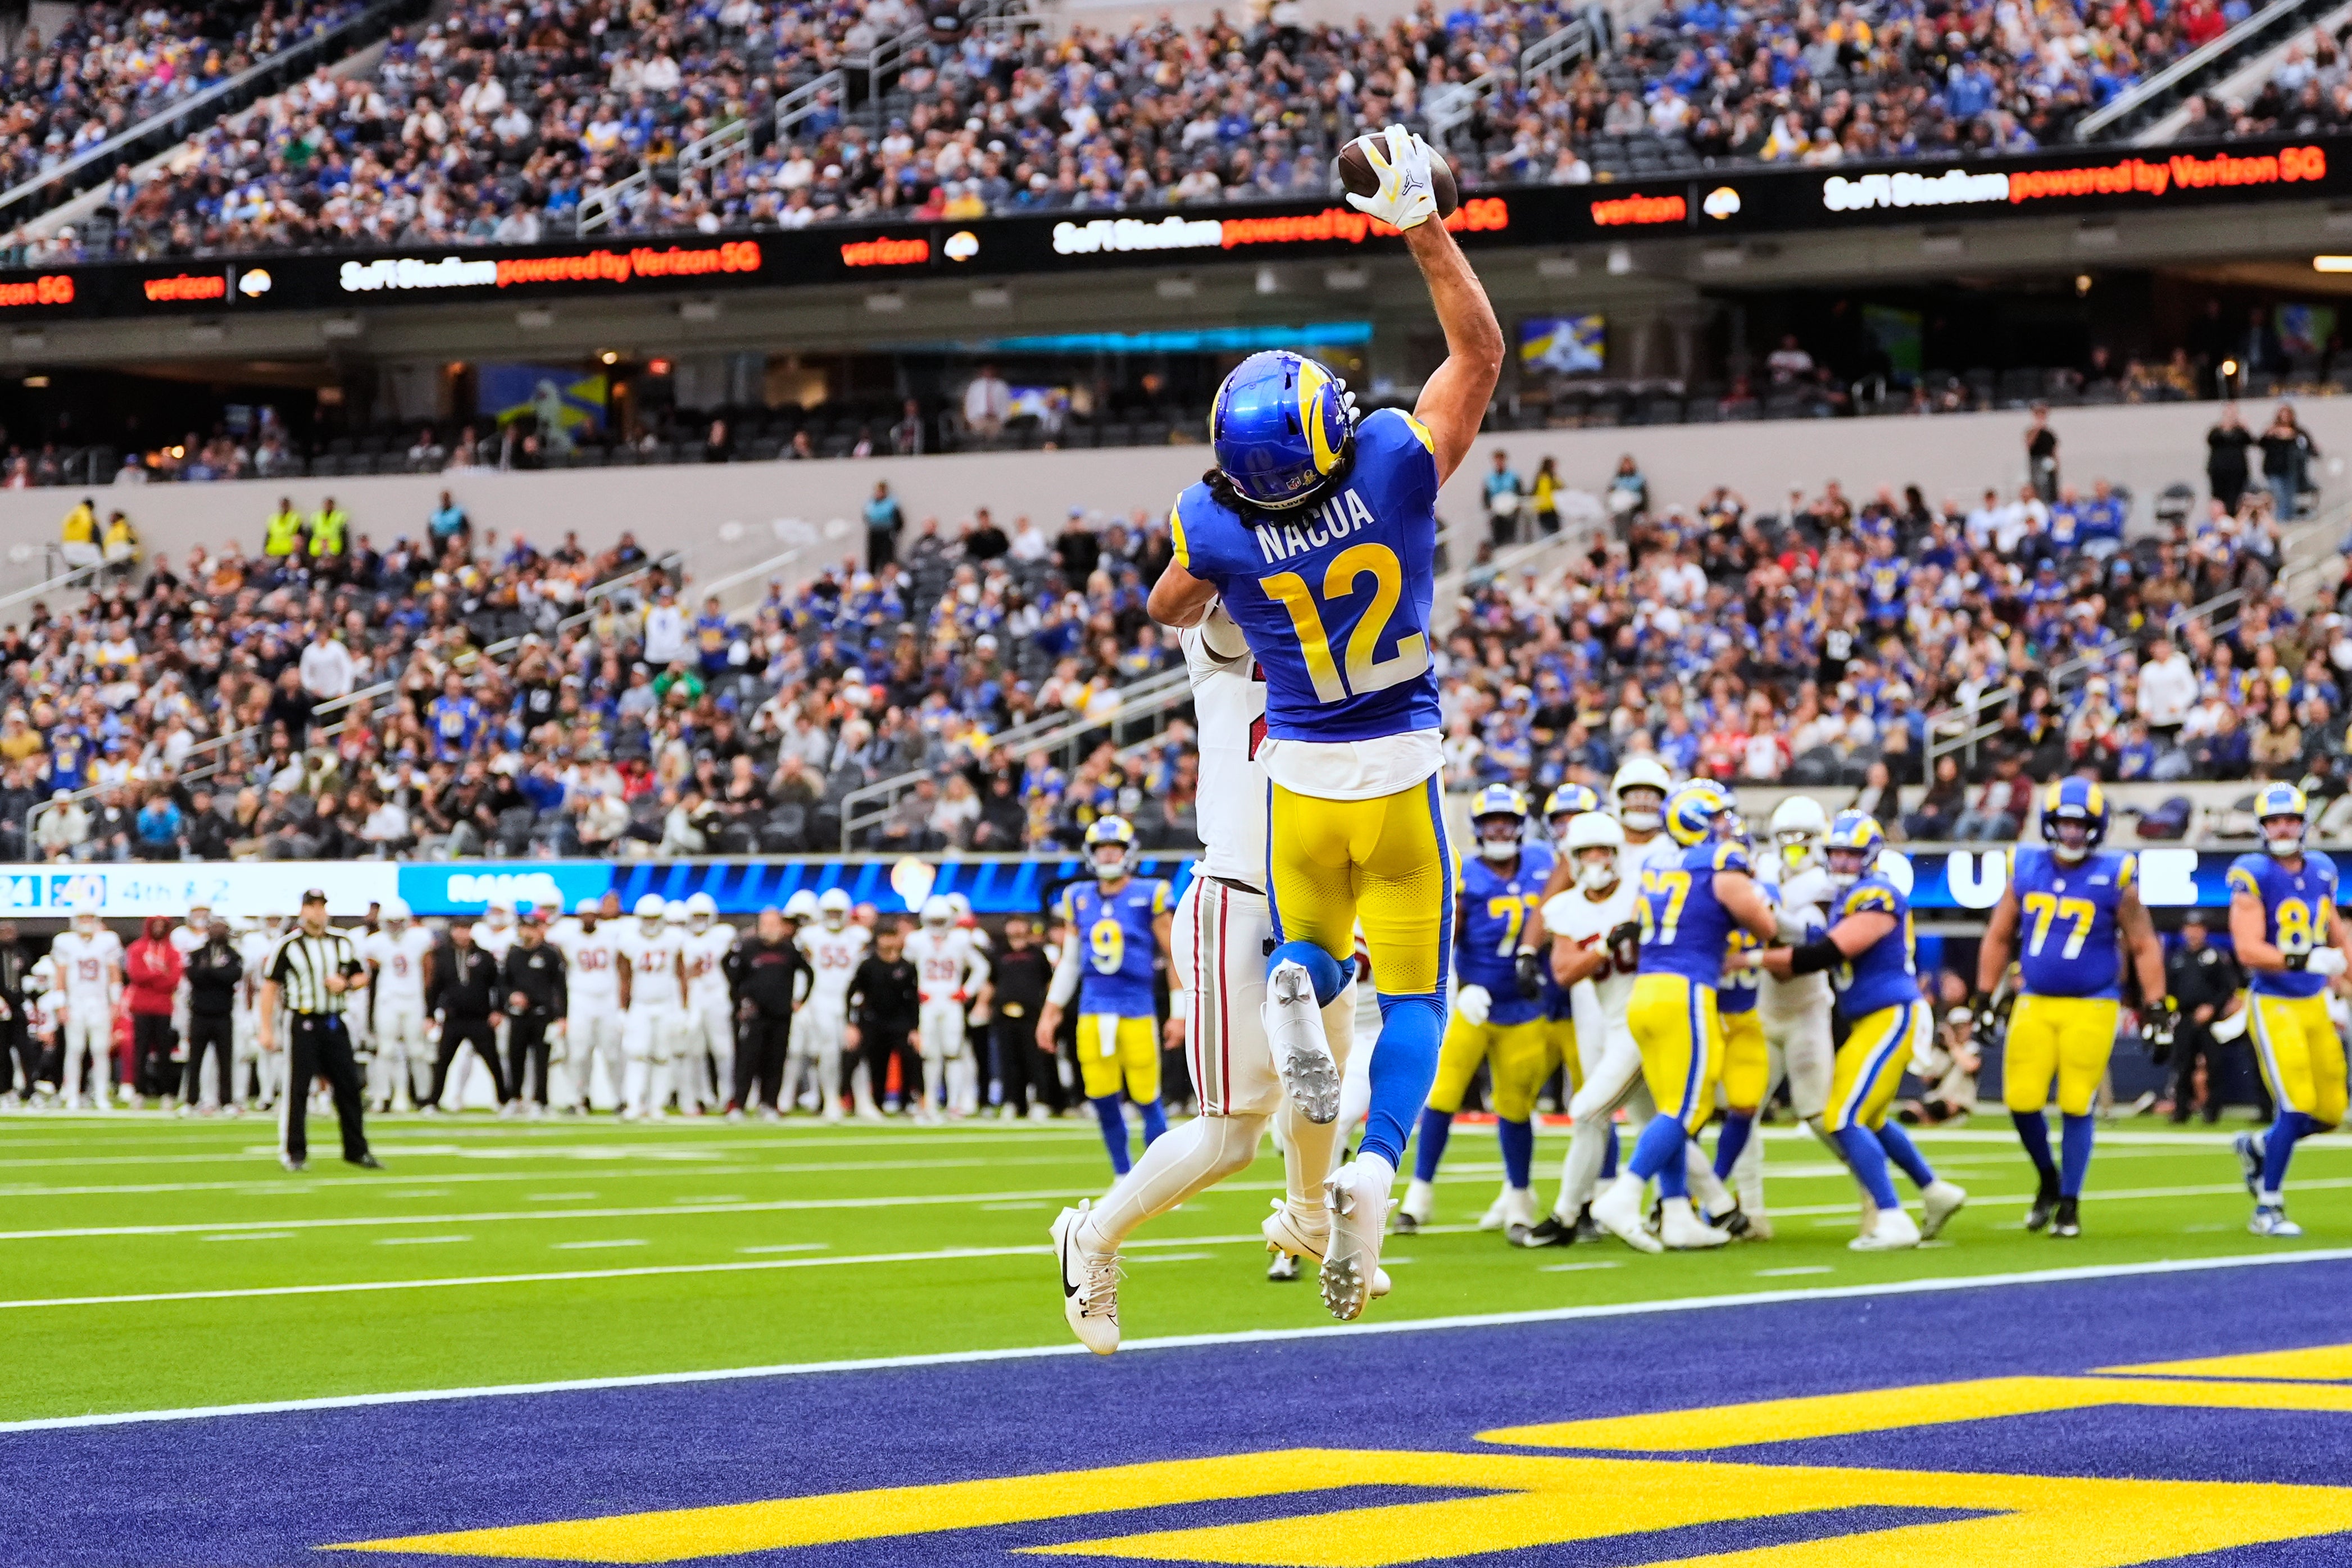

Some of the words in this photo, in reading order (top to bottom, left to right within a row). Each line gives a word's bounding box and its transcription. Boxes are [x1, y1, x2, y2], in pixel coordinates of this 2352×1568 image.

[1891, 169, 2010, 207] Stadium
[2009, 160, 2133, 203] powered
[2133, 160, 2170, 194] by
[2171, 153, 2278, 187] Verizon
[2279, 147, 2325, 181] 5G
[1114, 216, 1223, 251] Stadium
[1221, 208, 1334, 249] powered
[1334, 208, 1369, 243] by
[1465, 198, 1508, 230] 5G
[397, 257, 497, 288] Stadium
[496, 251, 601, 287] powered
[601, 250, 632, 282] by
[632, 247, 721, 276] Verizon
[721, 241, 761, 272] 5G
[1255, 488, 1375, 564] NACUA
[1259, 543, 1428, 703] 12
[211, 879, 229, 902] 2
[1089, 917, 1124, 975] 9
[1487, 894, 1540, 957] 7
[2023, 891, 2096, 960] 77
